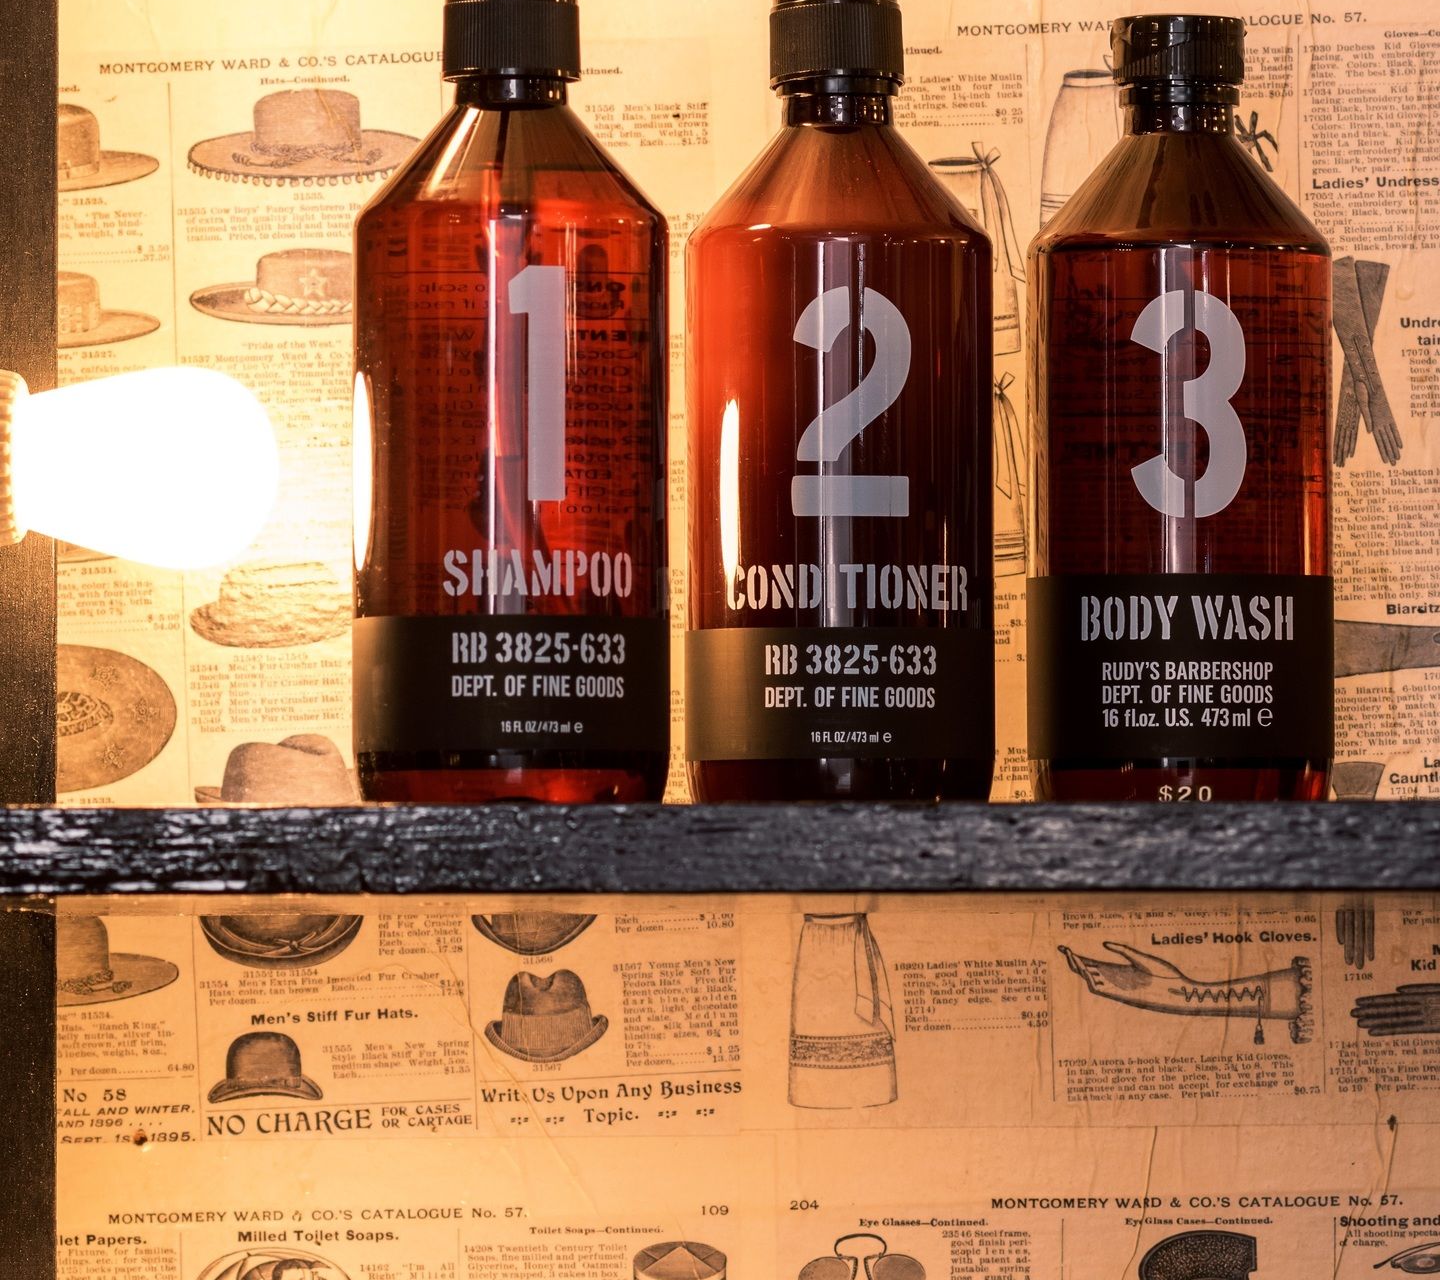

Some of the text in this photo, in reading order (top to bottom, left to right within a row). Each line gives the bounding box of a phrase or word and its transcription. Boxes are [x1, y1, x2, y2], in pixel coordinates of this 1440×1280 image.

[508, 265, 566, 501] 1
[791, 285, 911, 518] 2
[1130, 289, 1248, 519] 3
[443, 549, 632, 598] SHAMPOO
[727, 564, 968, 611] CONDITIONER
[1081, 595, 1294, 642] BODY WASH
[452, 632, 487, 663] RB
[765, 644, 798, 675] RB
[452, 675, 624, 698] DEPT. OF FINE GOODS
[1102, 661, 1274, 682] RUDY'S BARBERSHOP
[765, 686, 935, 708] DEPT. OF FINE GOODS
[1102, 685, 1273, 704] DEPT. OF FINE GOODS
[1151, 930, 1317, 946] Ladies' Hook Gloves.
[251, 1012, 300, 1026] Men's
[344, 1009, 371, 1022] Fur
[377, 1007, 419, 1021] Hats.
[207, 1108, 373, 1136] NO CHARGE
